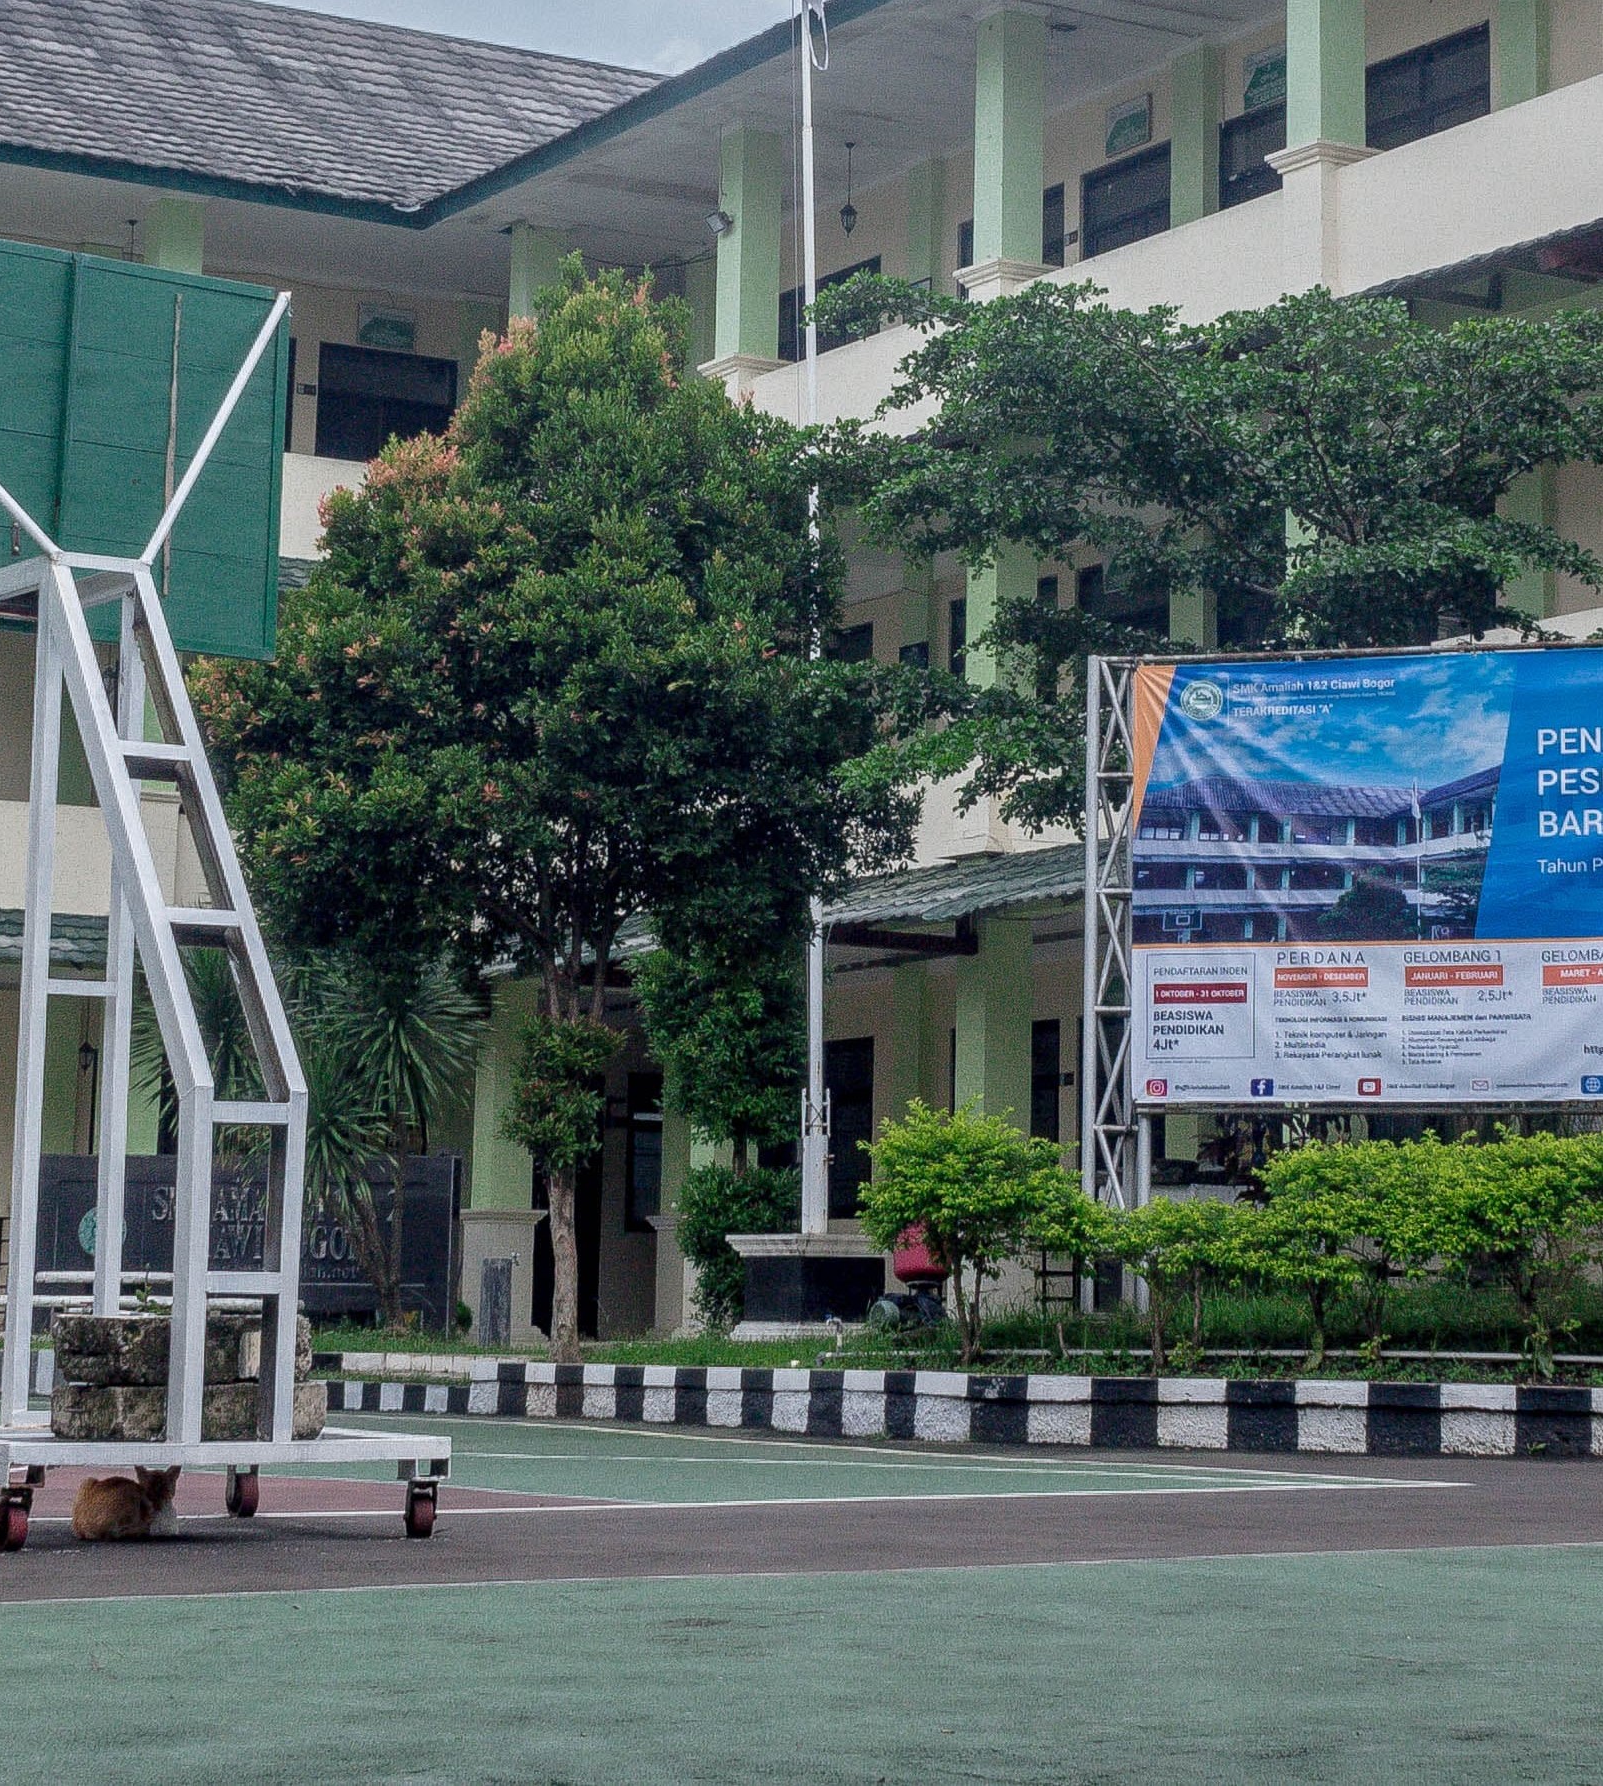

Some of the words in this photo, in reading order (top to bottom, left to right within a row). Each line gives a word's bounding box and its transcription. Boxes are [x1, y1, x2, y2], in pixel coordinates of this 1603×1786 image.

[1232, 683, 1258, 694] SMK
[1261, 680, 1304, 692] Amaliah
[1307, 680, 1328, 691] 1&2
[1330, 679, 1360, 690] Ciawi
[1362, 678, 1395, 690] Bogor
[1232, 704, 1316, 717] TERAKREDITASI
[1537, 767, 1603, 796] PES
[1537, 858, 1587, 874] Tahun
[1276, 951, 1366, 965] PERDANA
[1403, 950, 1491, 963] GELOMBANG
[1495, 950, 1501, 962] 1
[1541, 949, 1603, 963] GELOMB
[1153, 967, 1218, 976] PENDAFTARAN
[1220, 966, 1248, 975] INDEN
[1411, 972, 1449, 981] JANUARI
[1455, 971, 1498, 980] FEBRUARI
[1560, 969, 1590, 978] MARET
[1276, 972, 1318, 981] NOVEMBER
[1323, 972, 1366, 981] DESEMBER
[1160, 990, 1195, 998] OKTOBER
[1199, 990, 1209, 998] 31
[1210, 989, 1245, 998] OKTOBER
[1274, 990, 1319, 998] BEASISWA
[1404, 989, 1450, 997] BEASISWA
[1542, 987, 1589, 996] BEASISWA
[1273, 998, 1327, 1007] PENDIDIKAN
[1404, 997, 1459, 1006] PENDIDIKAN
[1542, 994, 1597, 1005] PENDIDIKAN
[1153, 1010, 1214, 1022] BEASISWA
[1427, 1014, 1473, 1022] MANAJEMEN
[1153, 1024, 1225, 1035] PENDIDIKAN
[1283, 1031, 1308, 1039] Teknik
[1354, 1031, 1387, 1040] Jaringan
[1283, 1041, 1326, 1049] Multimedia
[1283, 1051, 1320, 1061] Rekayasa
[1321, 1050, 1360, 1060] Perangkat
